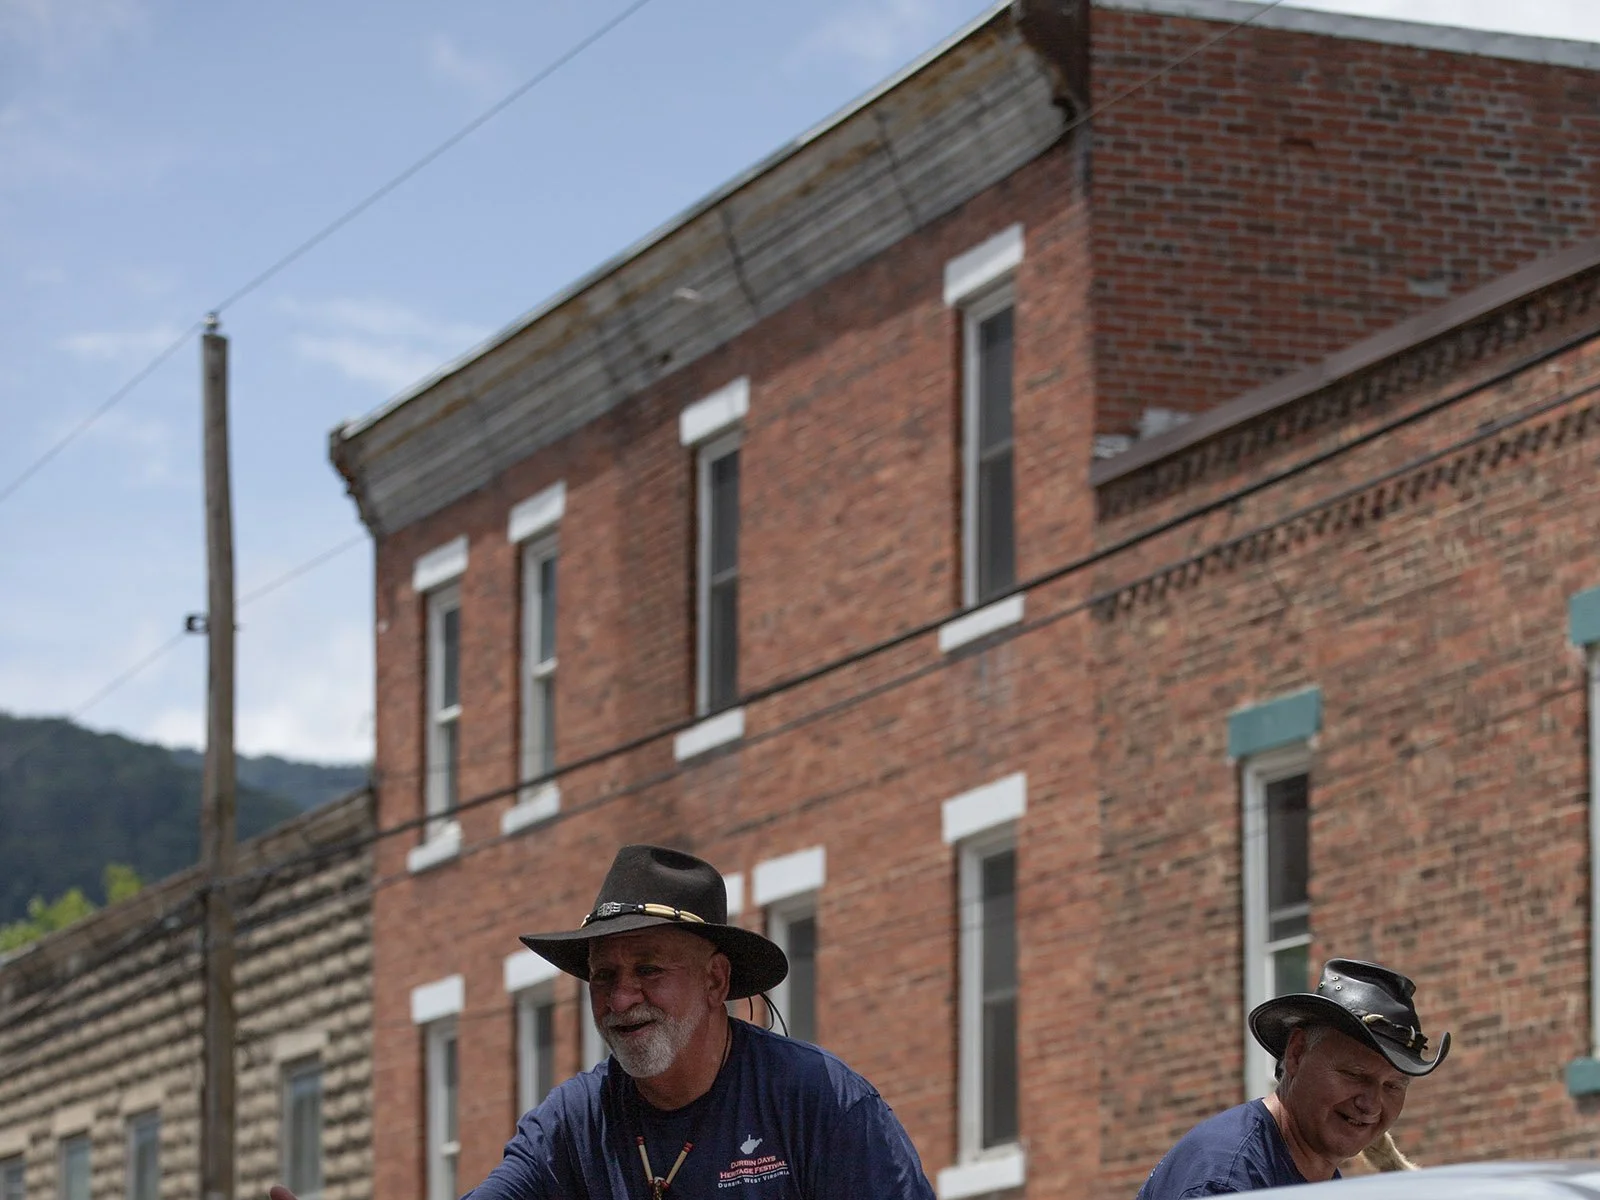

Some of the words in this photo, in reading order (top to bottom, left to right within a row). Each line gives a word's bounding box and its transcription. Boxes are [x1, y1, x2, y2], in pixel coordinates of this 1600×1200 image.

[730, 1160, 757, 1169] DURBIN
[757, 1155, 776, 1165] DAYS
[720, 1168, 754, 1179] HERITAGE
[754, 1160, 788, 1174] FESTIVAL
[762, 1170, 790, 1181] VIRGINIA
